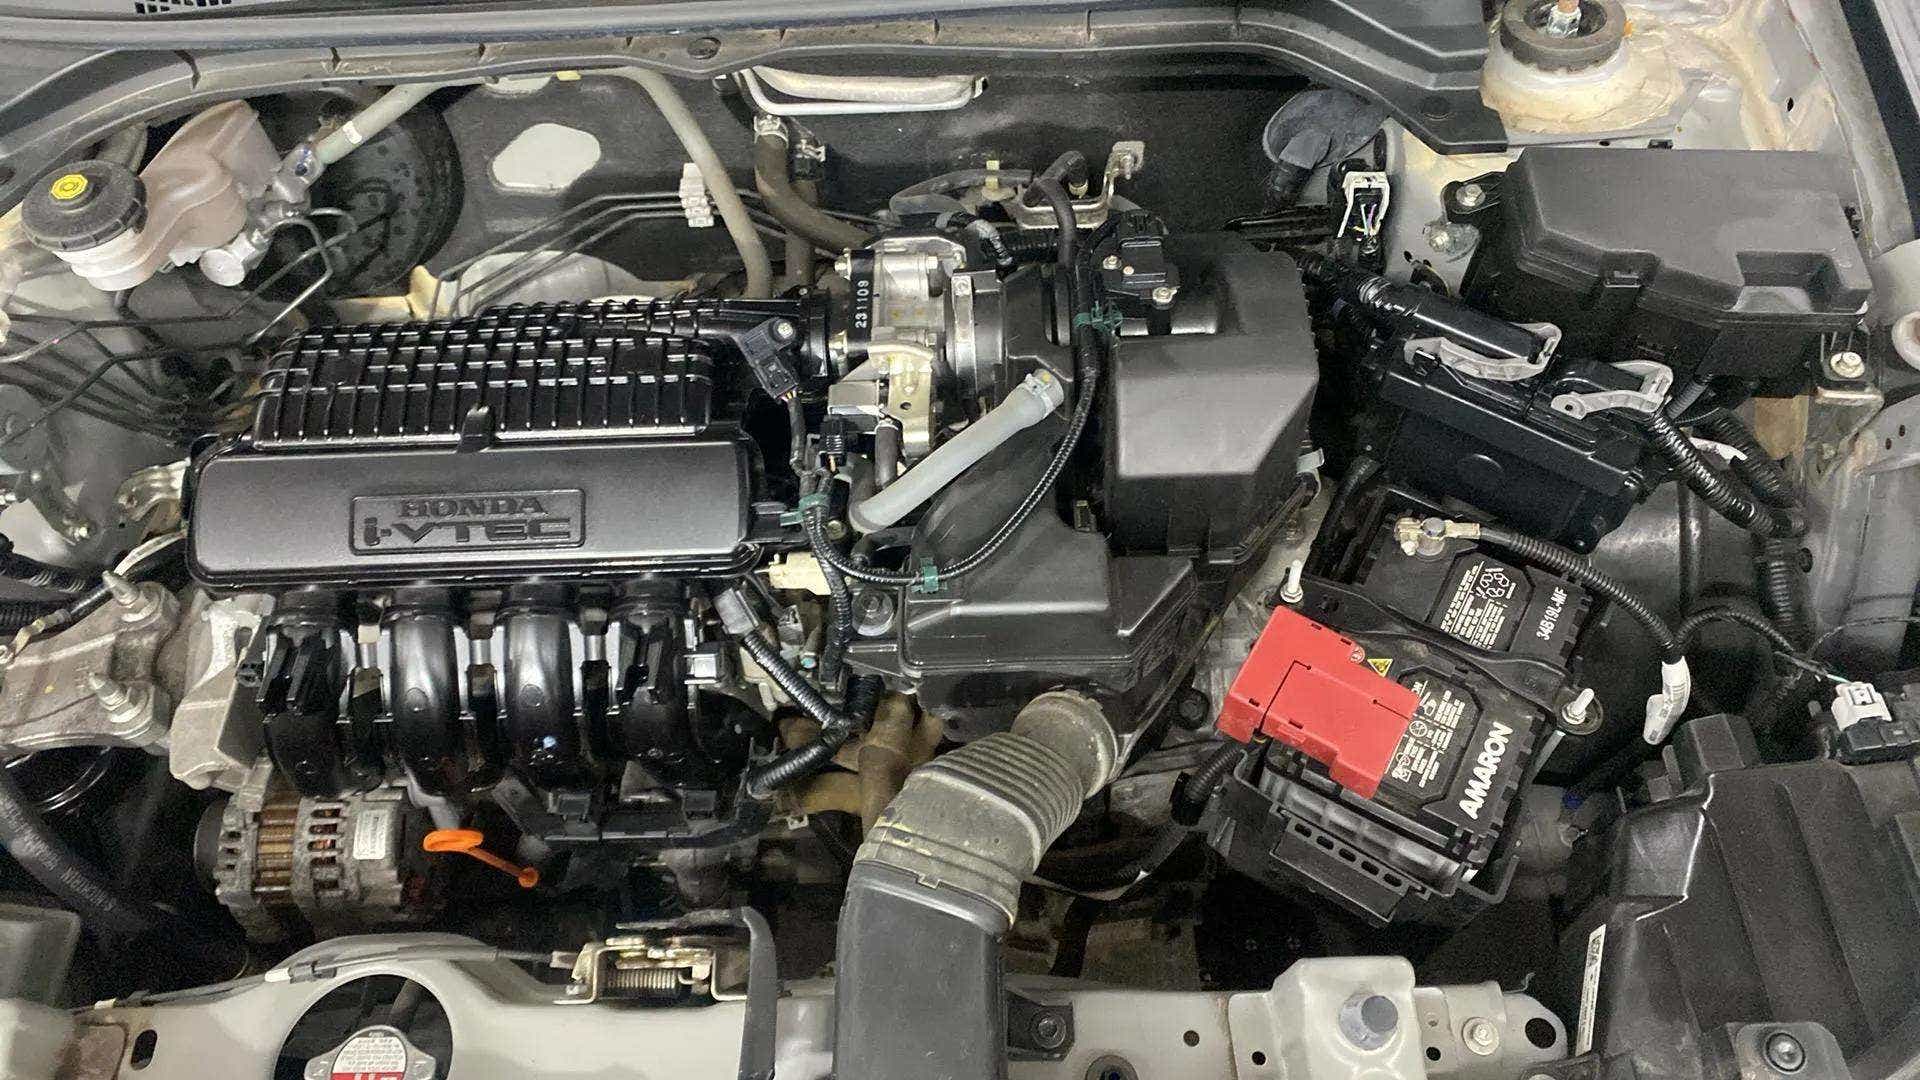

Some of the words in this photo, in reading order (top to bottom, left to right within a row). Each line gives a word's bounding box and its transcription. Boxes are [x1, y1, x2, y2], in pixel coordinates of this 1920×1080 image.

[855, 280, 869, 328] 231109
[364, 517, 571, 546] i-VTEC
[399, 497, 548, 518] HONDA
[1535, 586, 1568, 641] 34B19L-MF
[1459, 721, 1513, 820] AMARON
